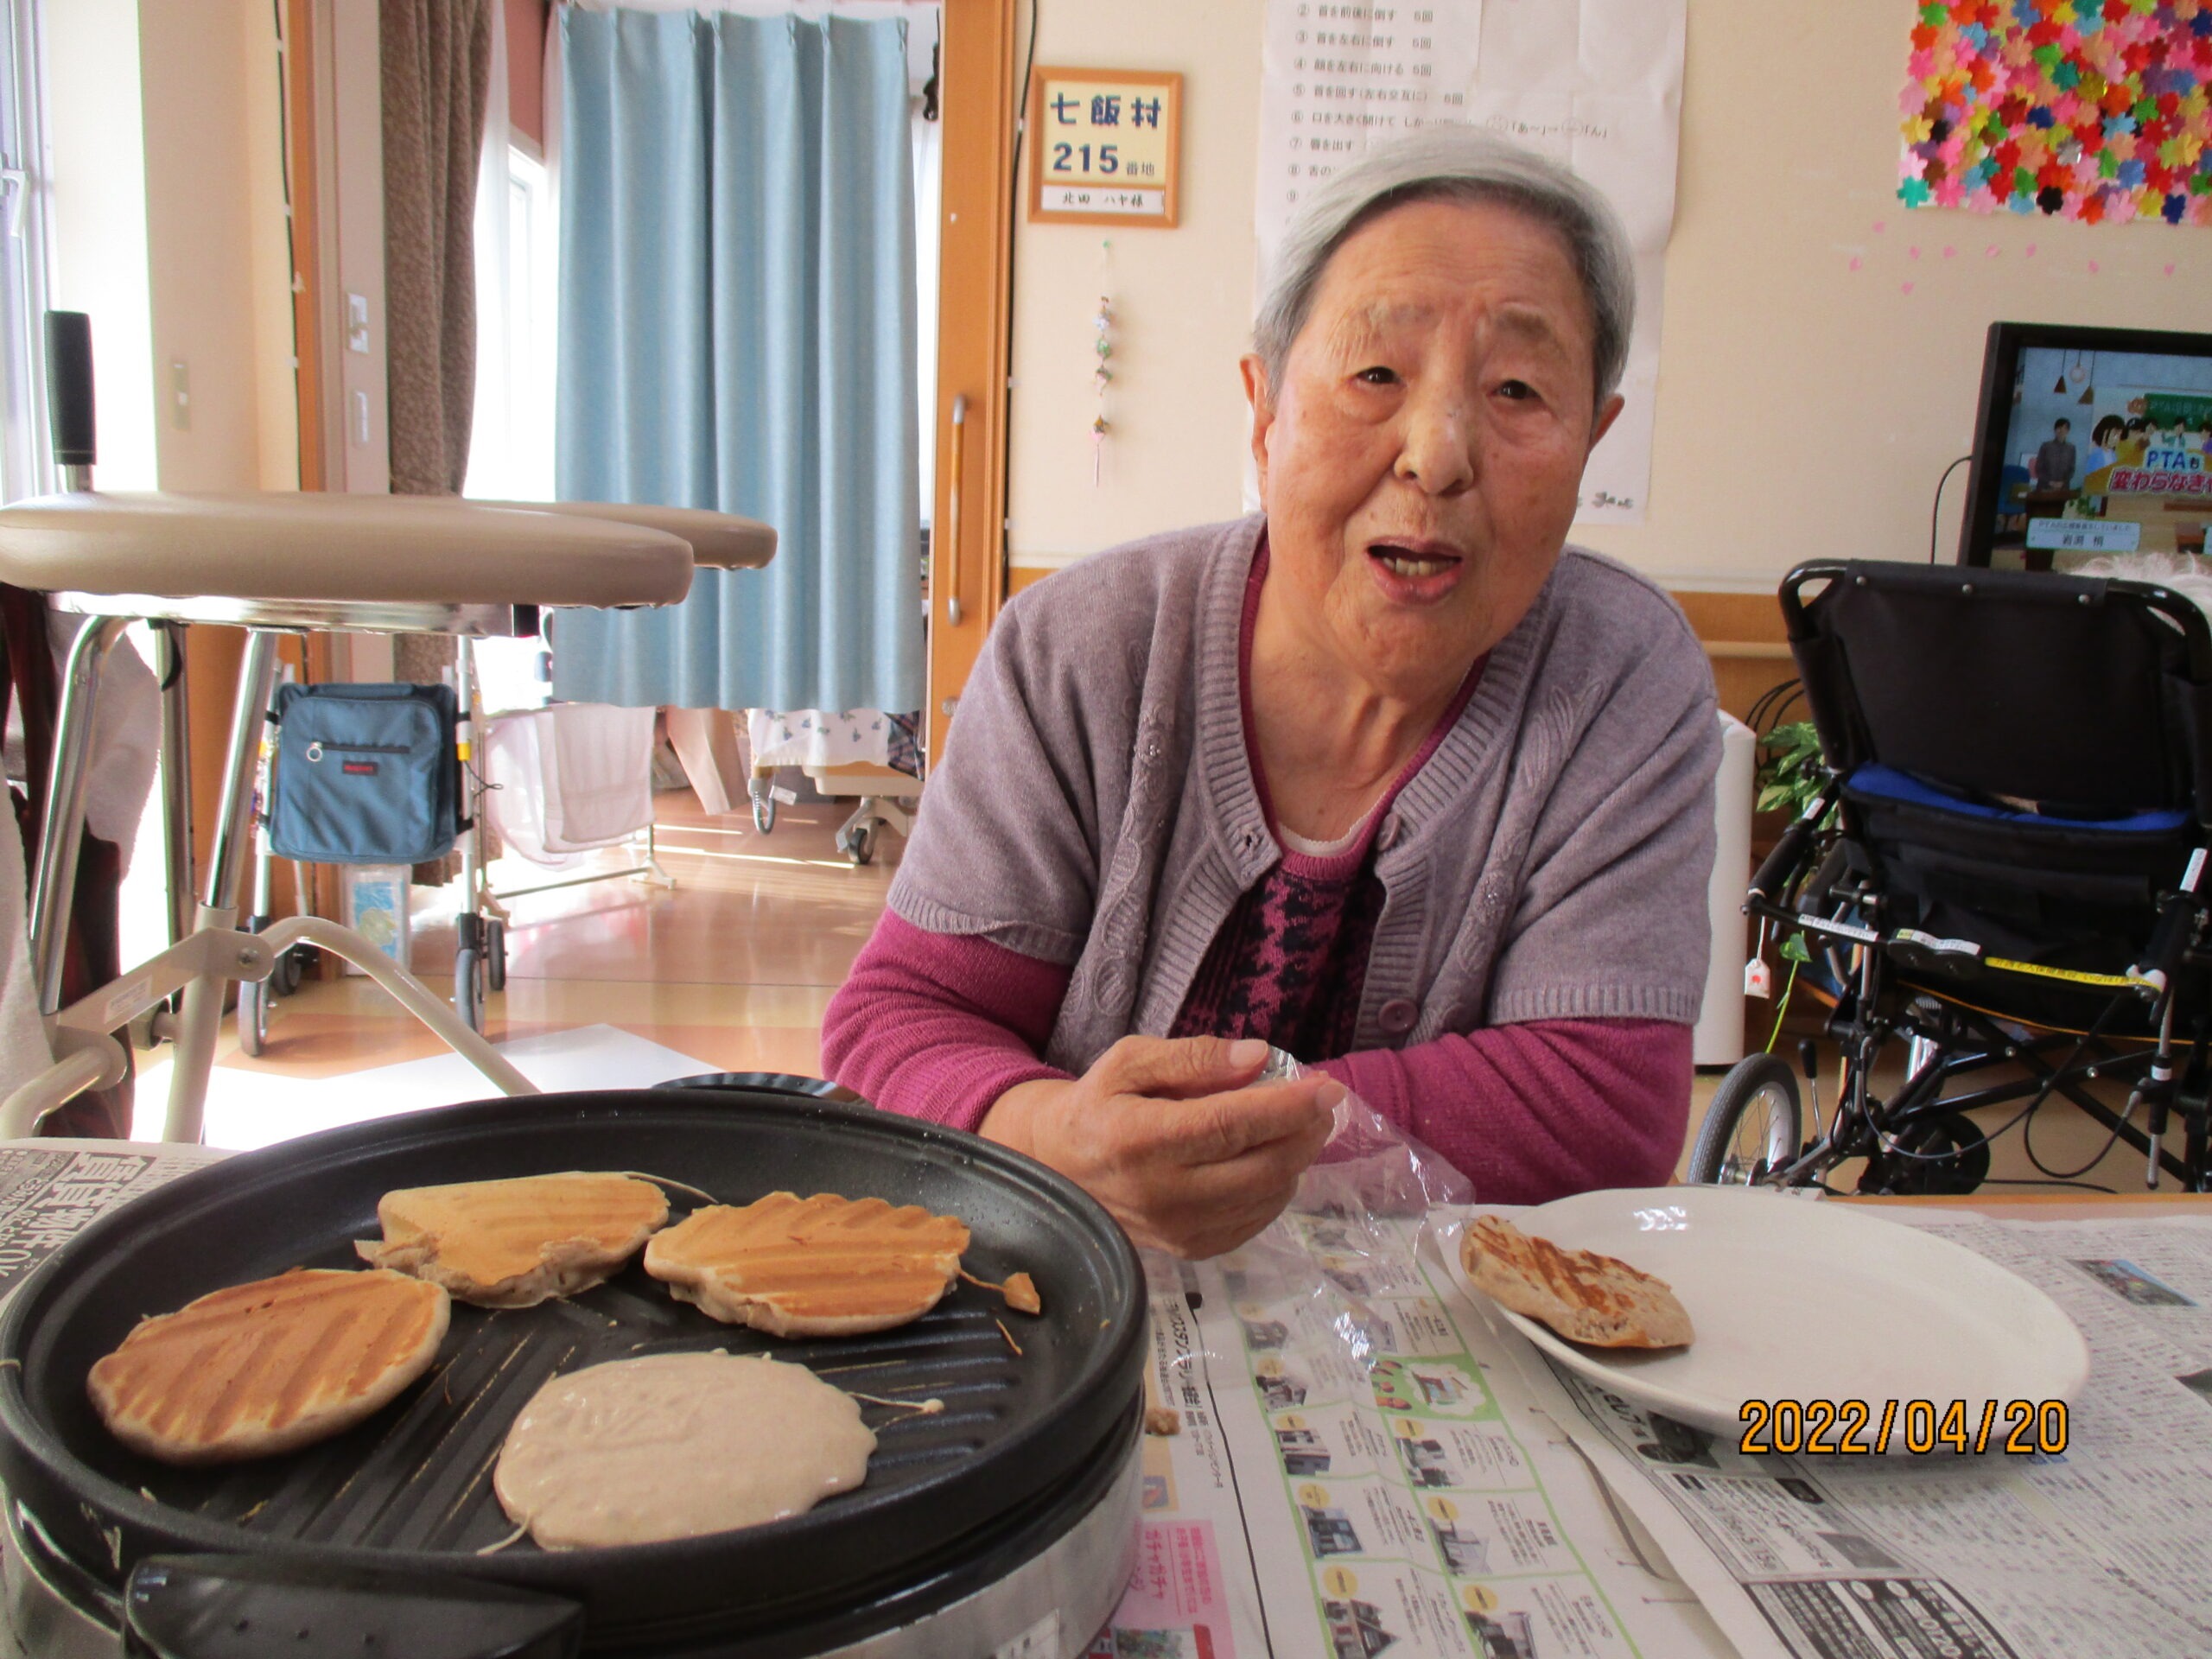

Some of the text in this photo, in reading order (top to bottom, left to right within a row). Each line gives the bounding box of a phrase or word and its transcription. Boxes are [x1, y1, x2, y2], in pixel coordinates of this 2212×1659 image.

[1050, 92, 1161, 129] 七飯村
[1053, 142, 1155, 177] 215 番地
